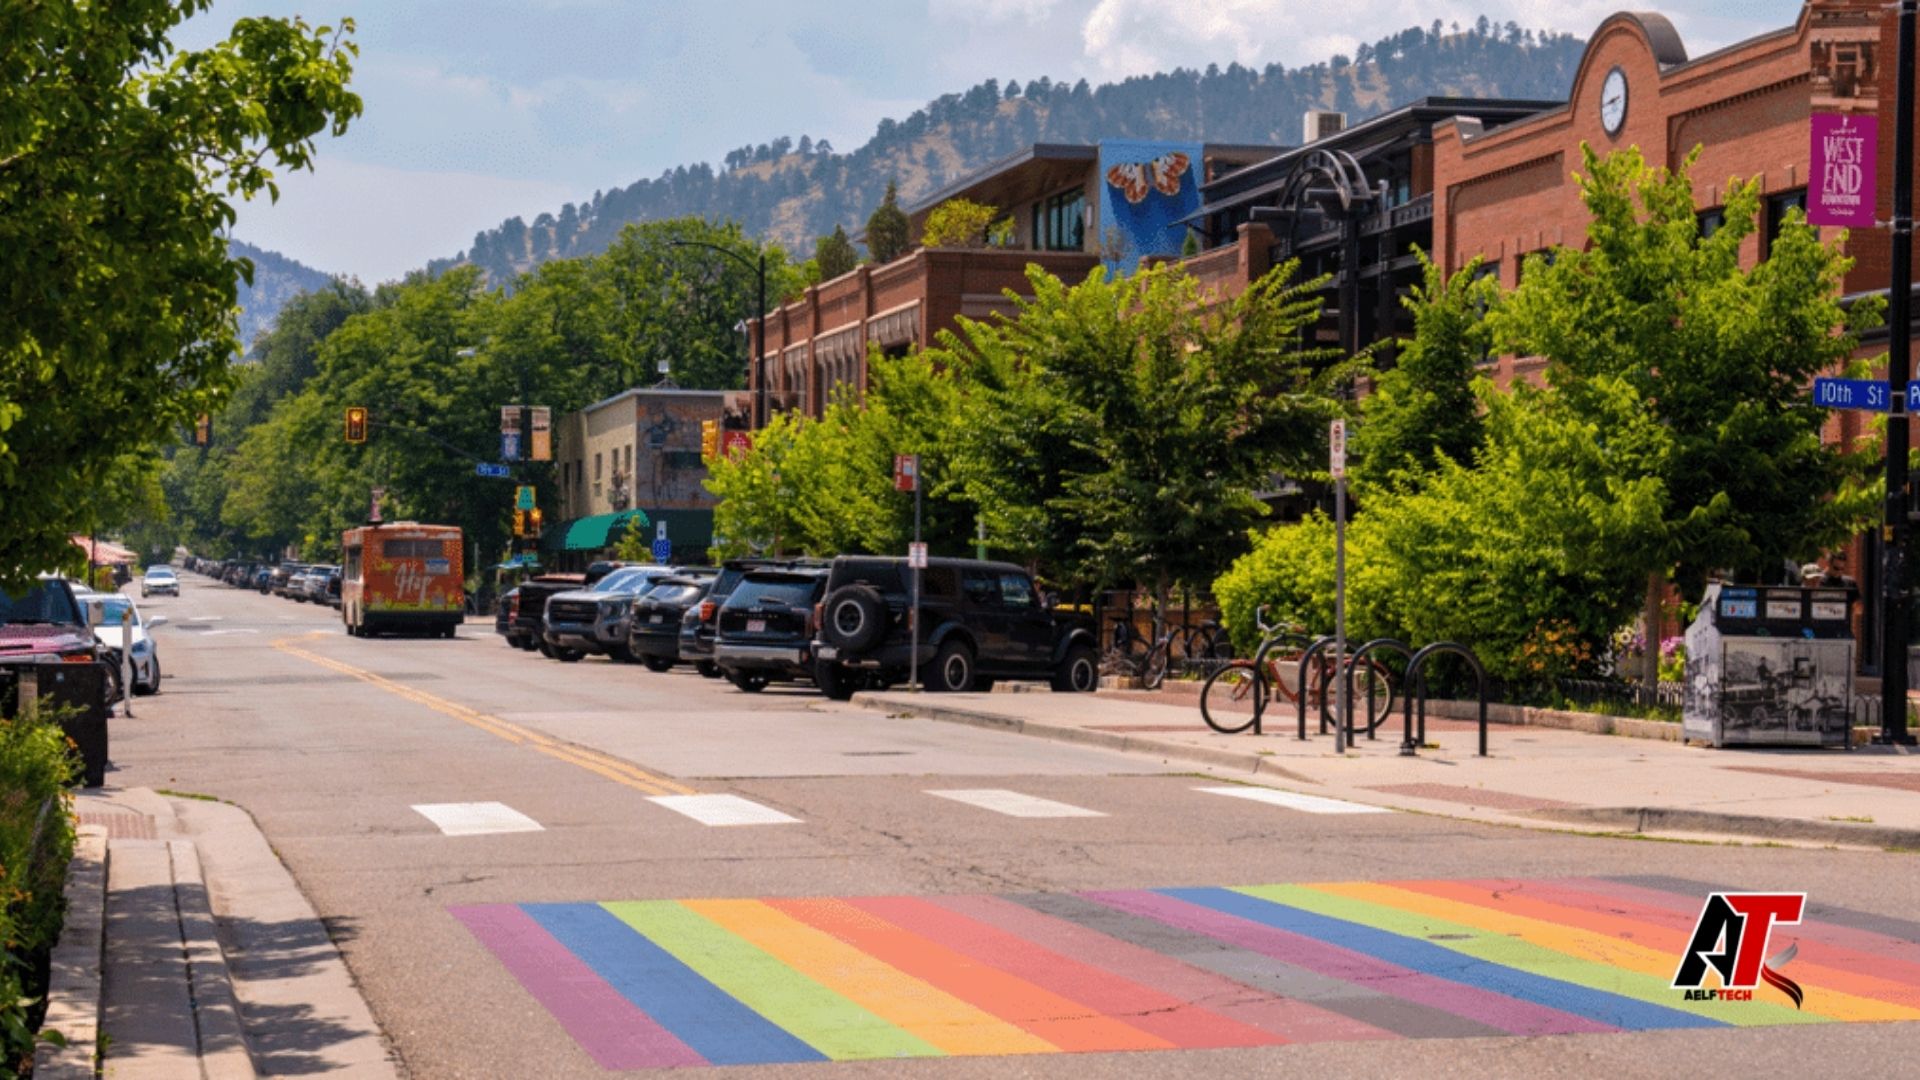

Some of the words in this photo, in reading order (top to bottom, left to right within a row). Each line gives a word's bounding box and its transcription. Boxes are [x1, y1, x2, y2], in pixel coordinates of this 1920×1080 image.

[1823, 136, 1864, 163] WEST
[1823, 163, 1862, 194] END
[1821, 382, 1852, 403] 10th
[1867, 384, 1884, 404] St
